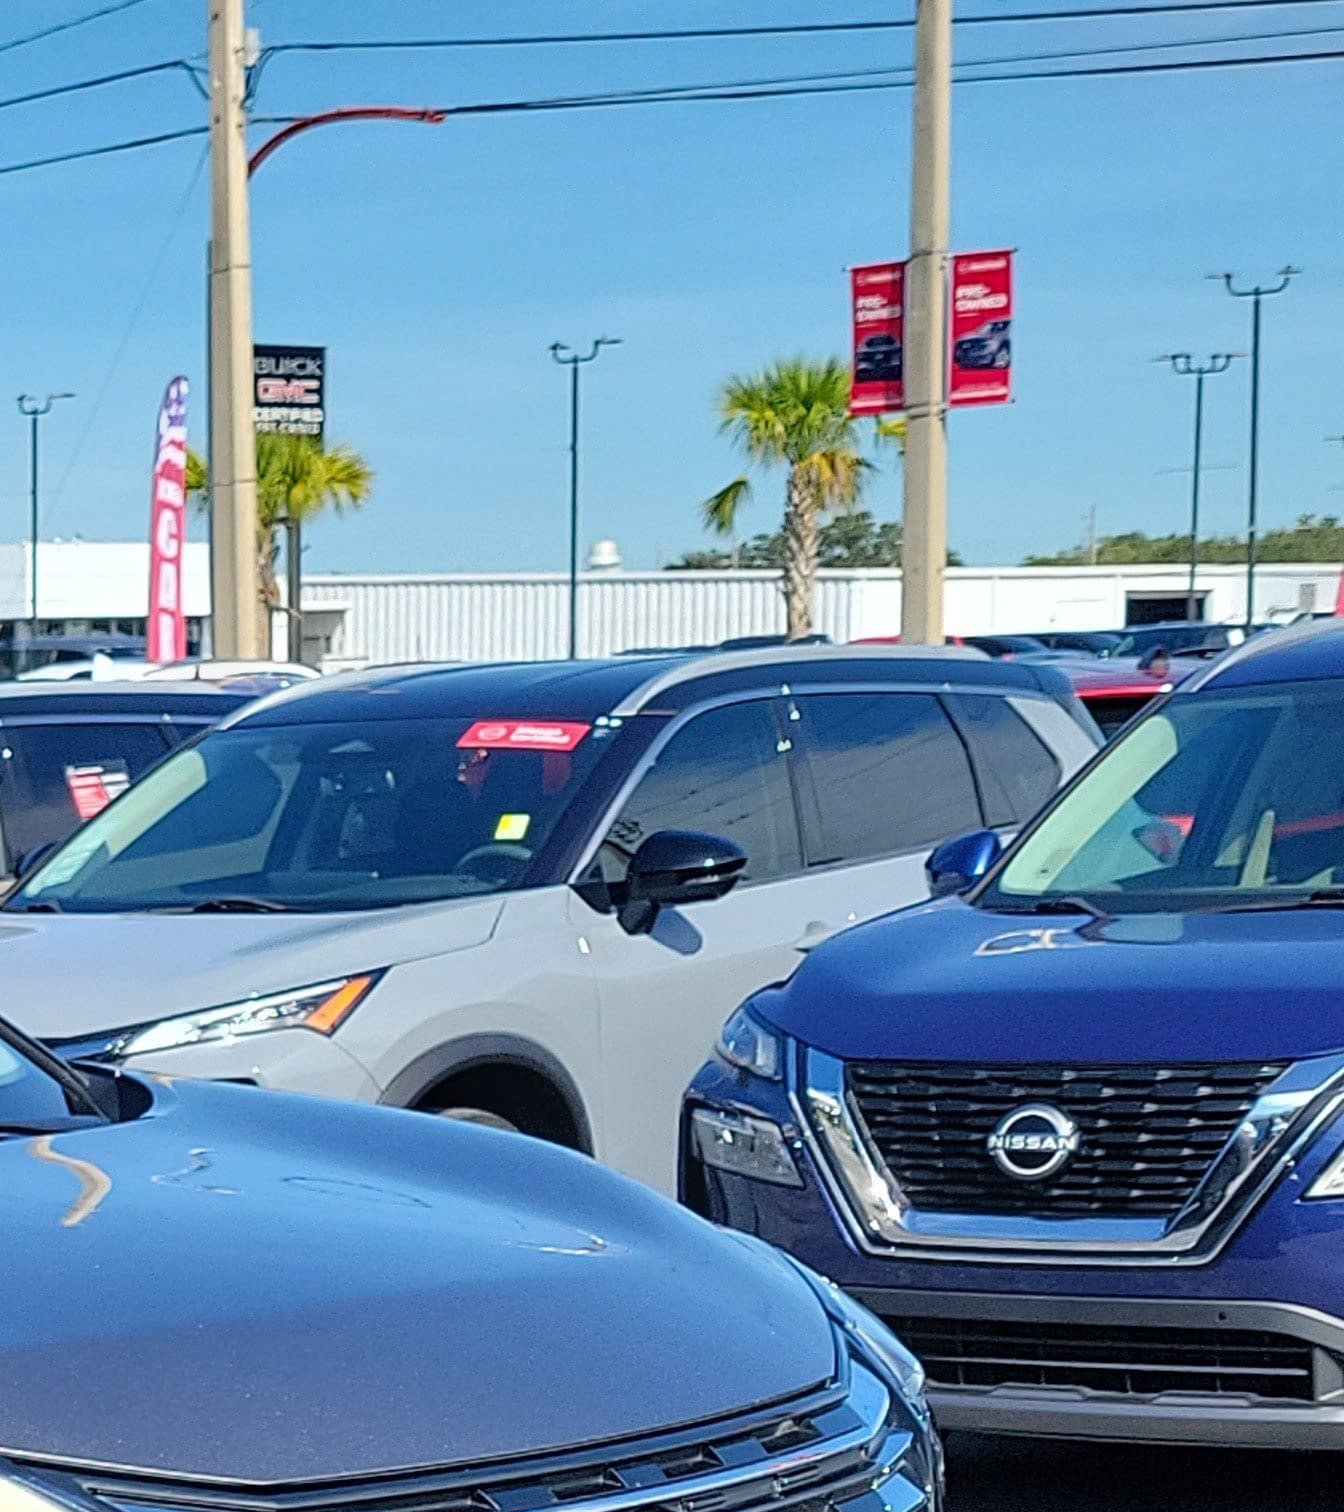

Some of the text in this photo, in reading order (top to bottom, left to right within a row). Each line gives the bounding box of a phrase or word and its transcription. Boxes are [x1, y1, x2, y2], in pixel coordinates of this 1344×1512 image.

[254, 356, 323, 376] BUICK
[257, 378, 321, 404] GMC
[987, 1133, 1076, 1150] NISSAN
